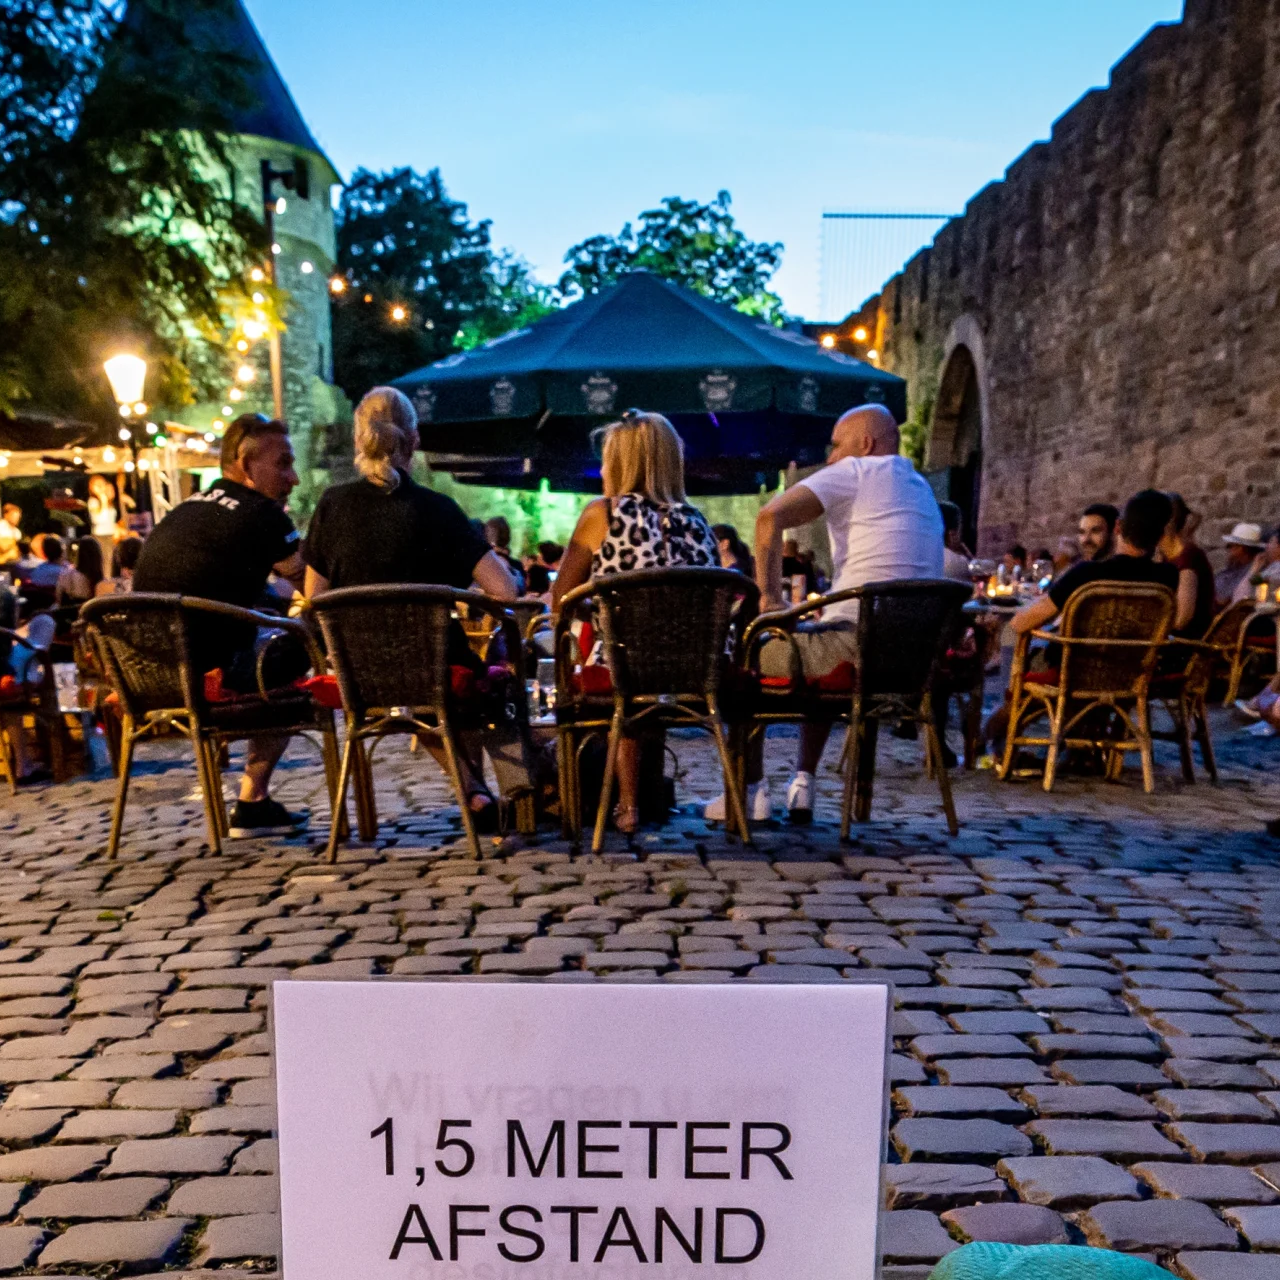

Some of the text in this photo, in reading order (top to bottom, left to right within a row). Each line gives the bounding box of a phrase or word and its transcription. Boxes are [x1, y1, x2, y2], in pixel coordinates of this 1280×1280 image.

[369, 1117, 795, 1188] 1,5 METER
[387, 1203, 767, 1265] AFSTAND
